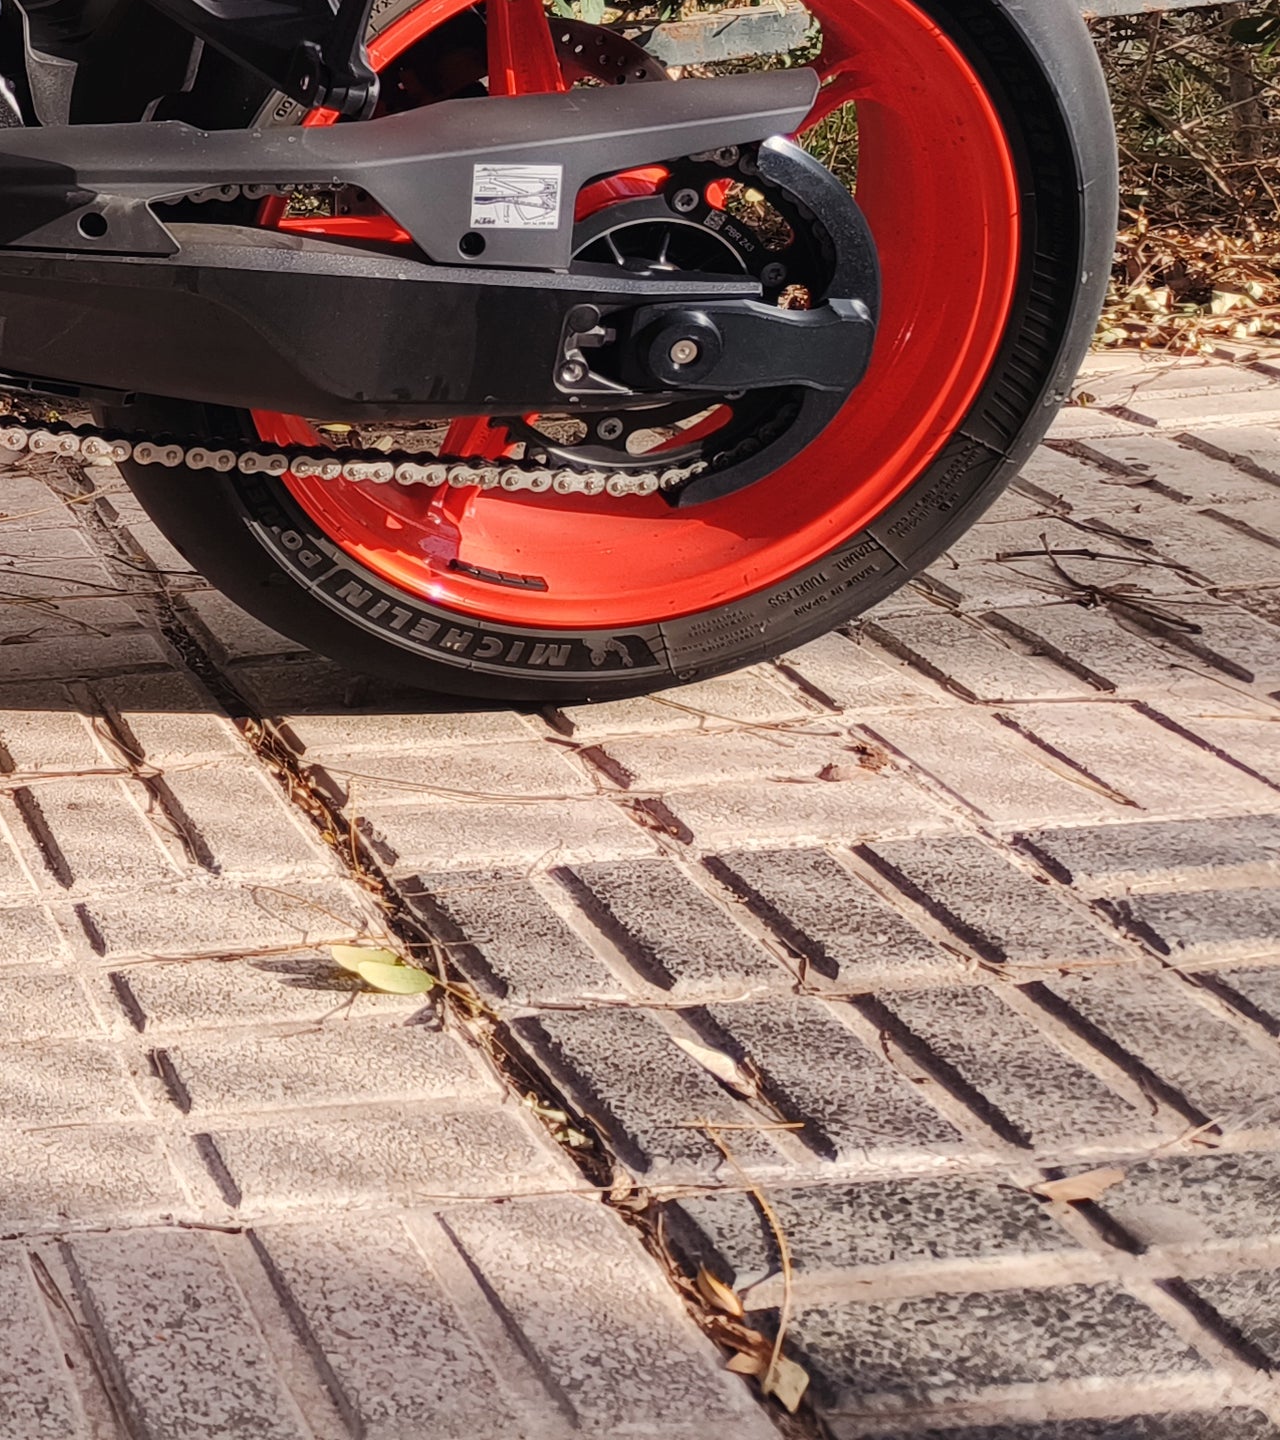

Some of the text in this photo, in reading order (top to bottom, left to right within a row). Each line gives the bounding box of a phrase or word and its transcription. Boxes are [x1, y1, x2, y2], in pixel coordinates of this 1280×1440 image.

[846, 564, 877, 588] MADE
[830, 586, 844, 598] IN
[332, 575, 573, 667] MICHELIN
